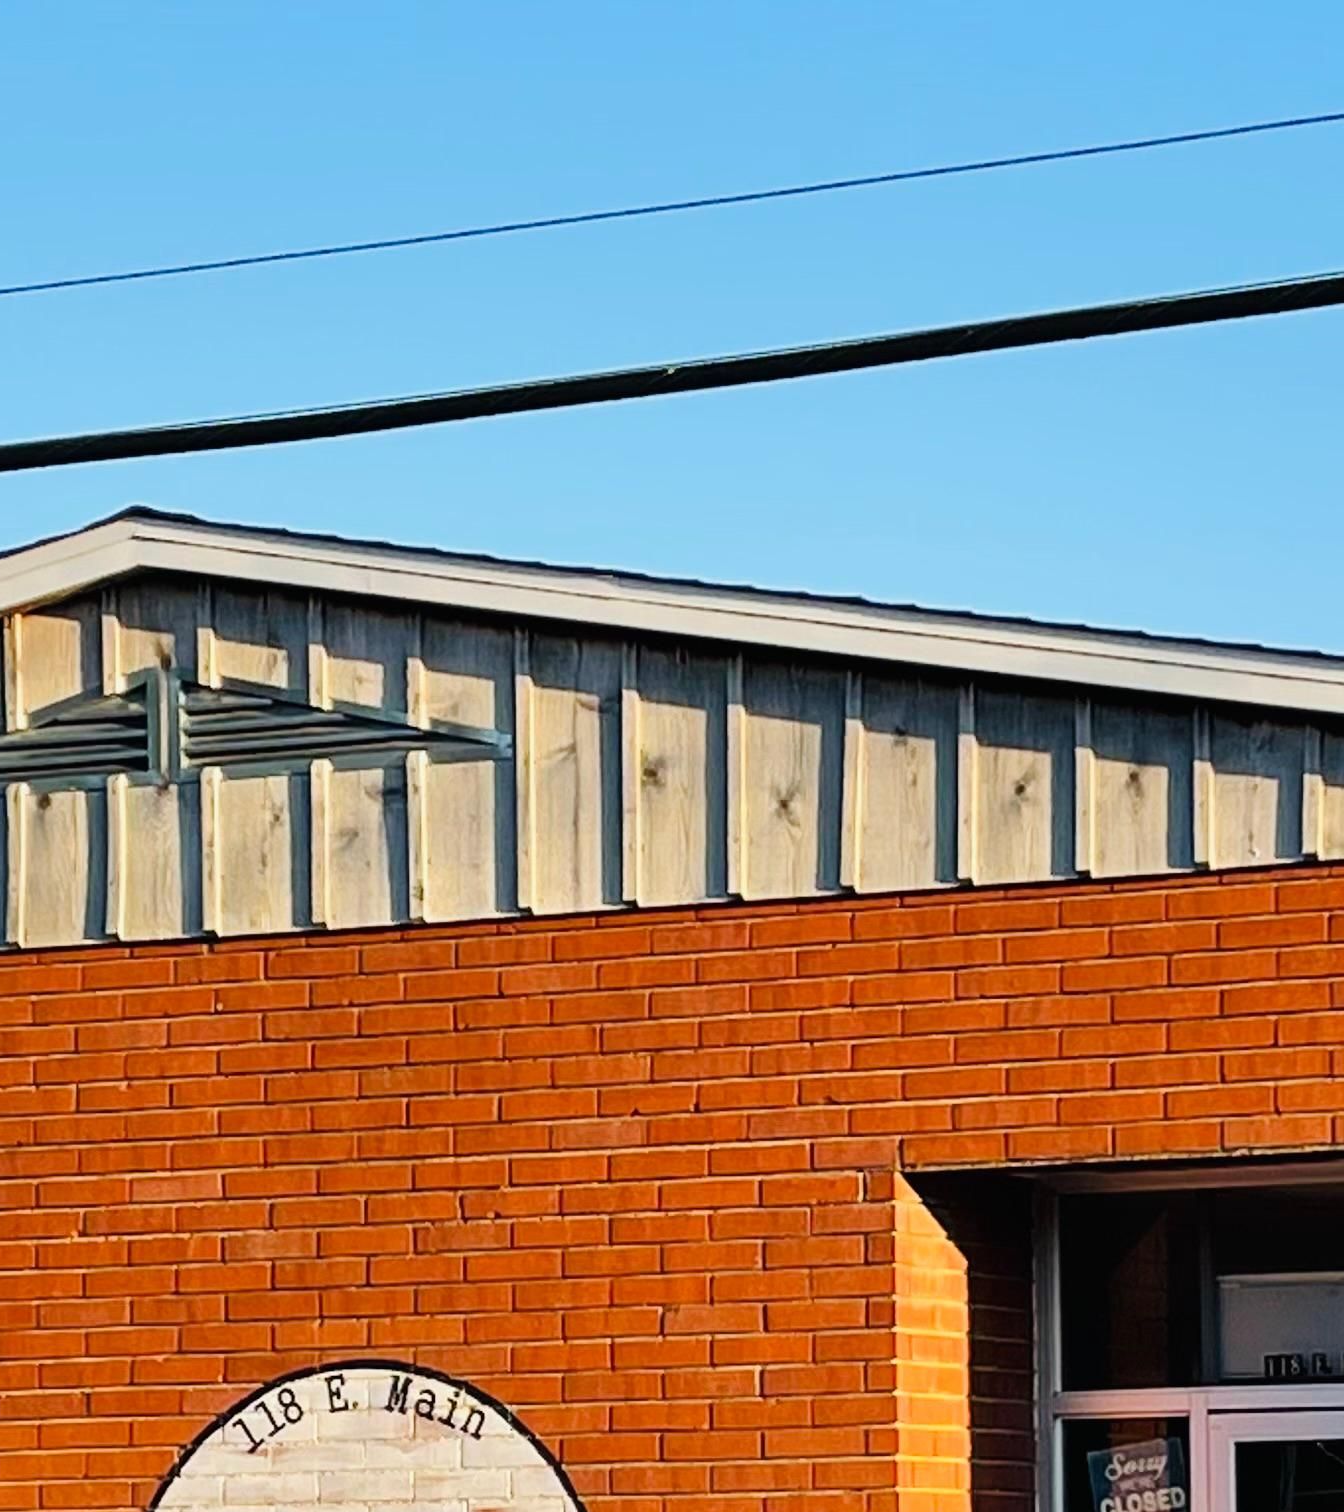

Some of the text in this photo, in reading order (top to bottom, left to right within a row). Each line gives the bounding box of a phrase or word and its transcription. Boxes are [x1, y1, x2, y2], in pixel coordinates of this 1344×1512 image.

[1268, 1355, 1301, 1376] 118
[232, 1389, 304, 1454] 118
[385, 1374, 487, 1440] Main
[1104, 1454, 1167, 1481] Sorry
